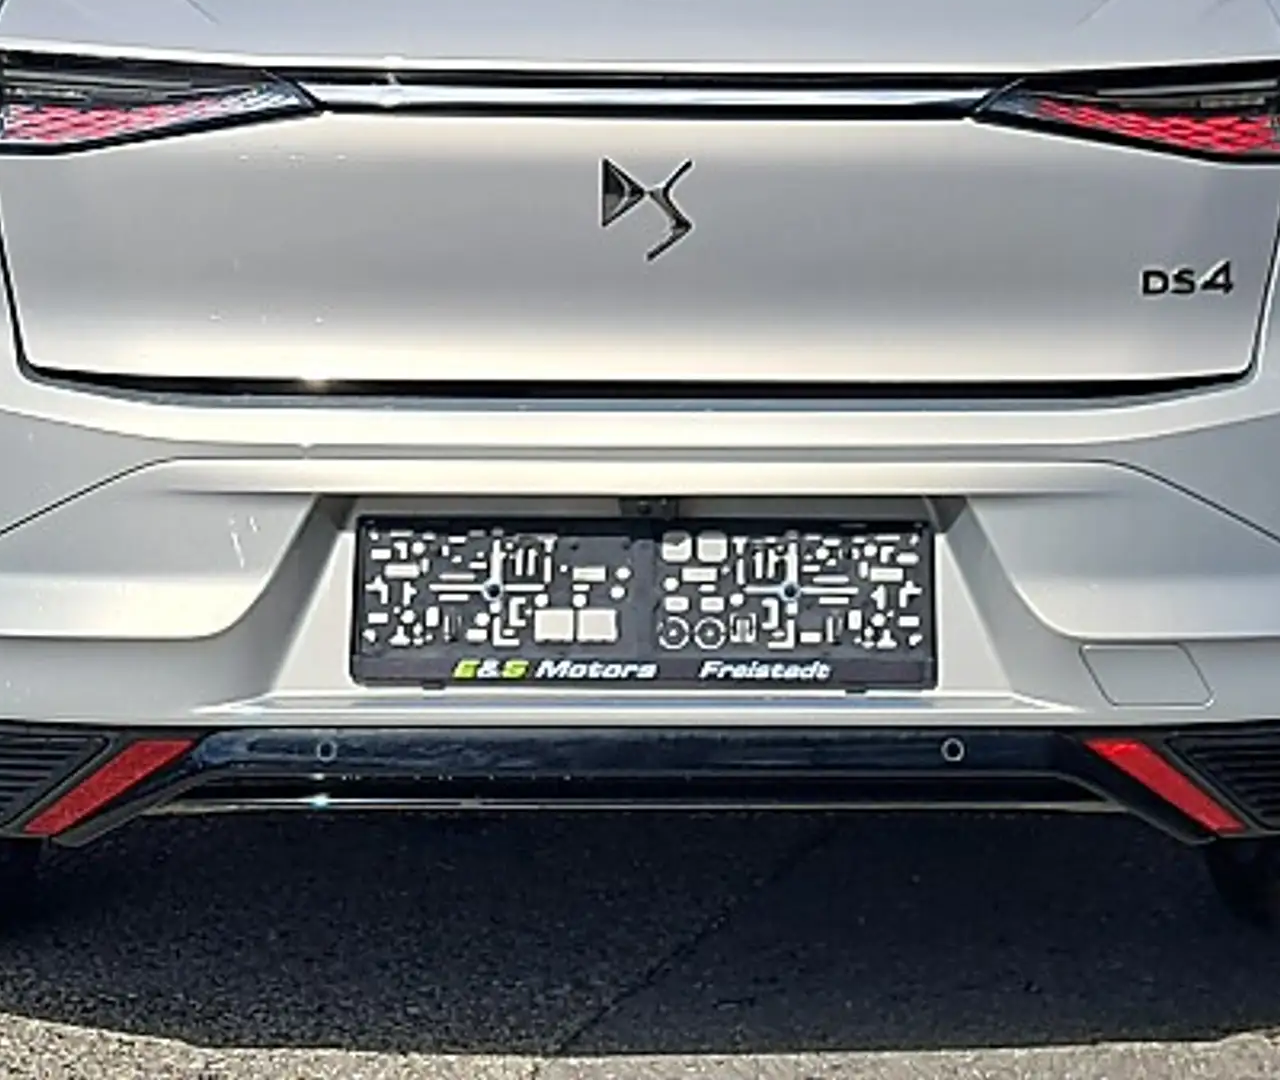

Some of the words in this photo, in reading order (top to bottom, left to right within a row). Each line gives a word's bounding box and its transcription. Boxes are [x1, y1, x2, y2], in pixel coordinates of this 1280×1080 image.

[452, 659, 531, 679] E&S
[534, 659, 658, 680] Motors
[698, 659, 833, 681] Freistadt
